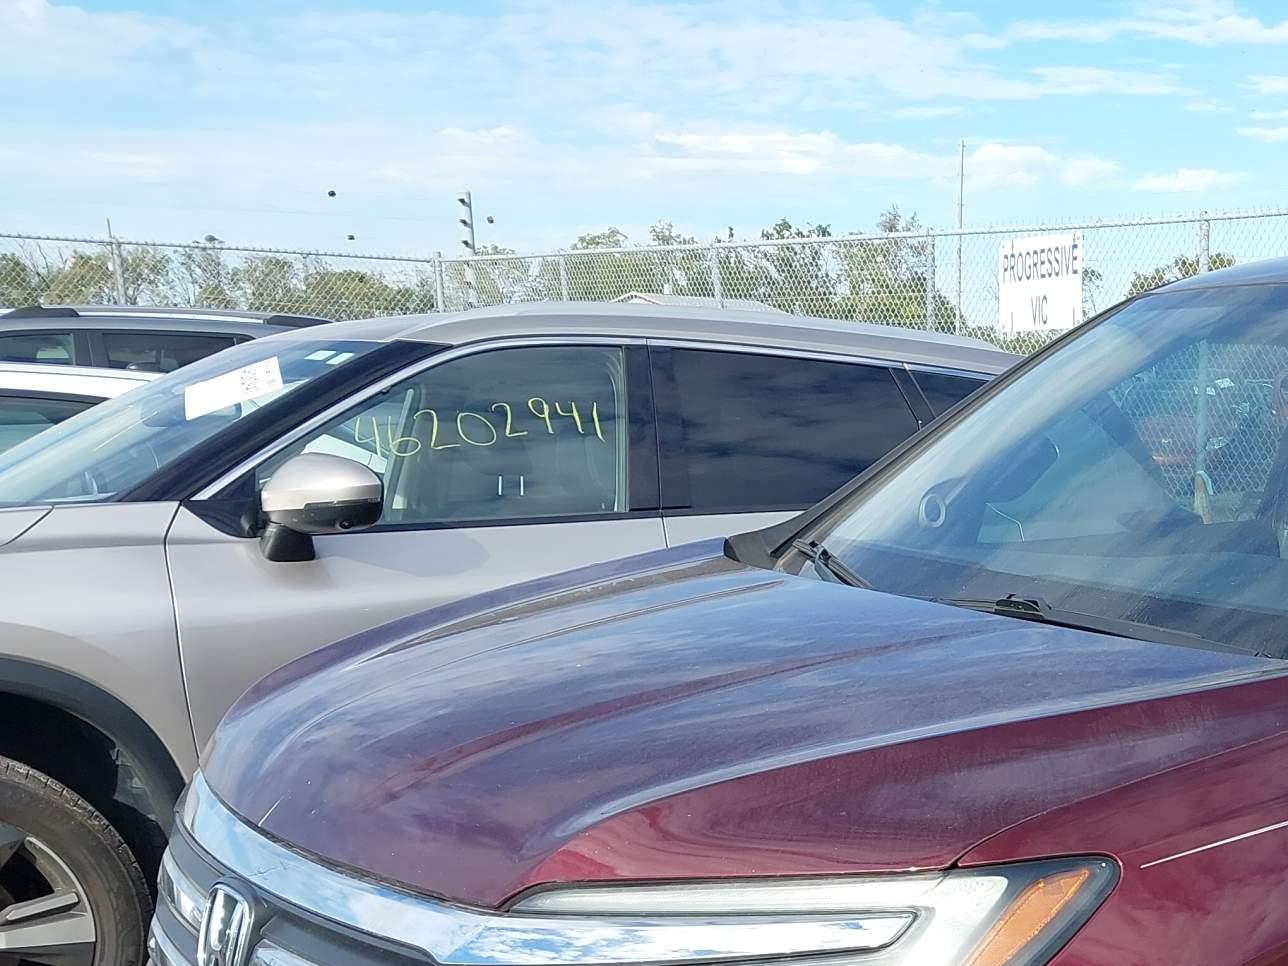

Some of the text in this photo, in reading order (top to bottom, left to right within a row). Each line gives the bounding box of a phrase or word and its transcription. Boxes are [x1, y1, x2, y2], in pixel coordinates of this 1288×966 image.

[1003, 243, 1079, 284] PROGRESSIVE
[1030, 295, 1049, 327] VIC
[354, 397, 606, 457] 46202941
